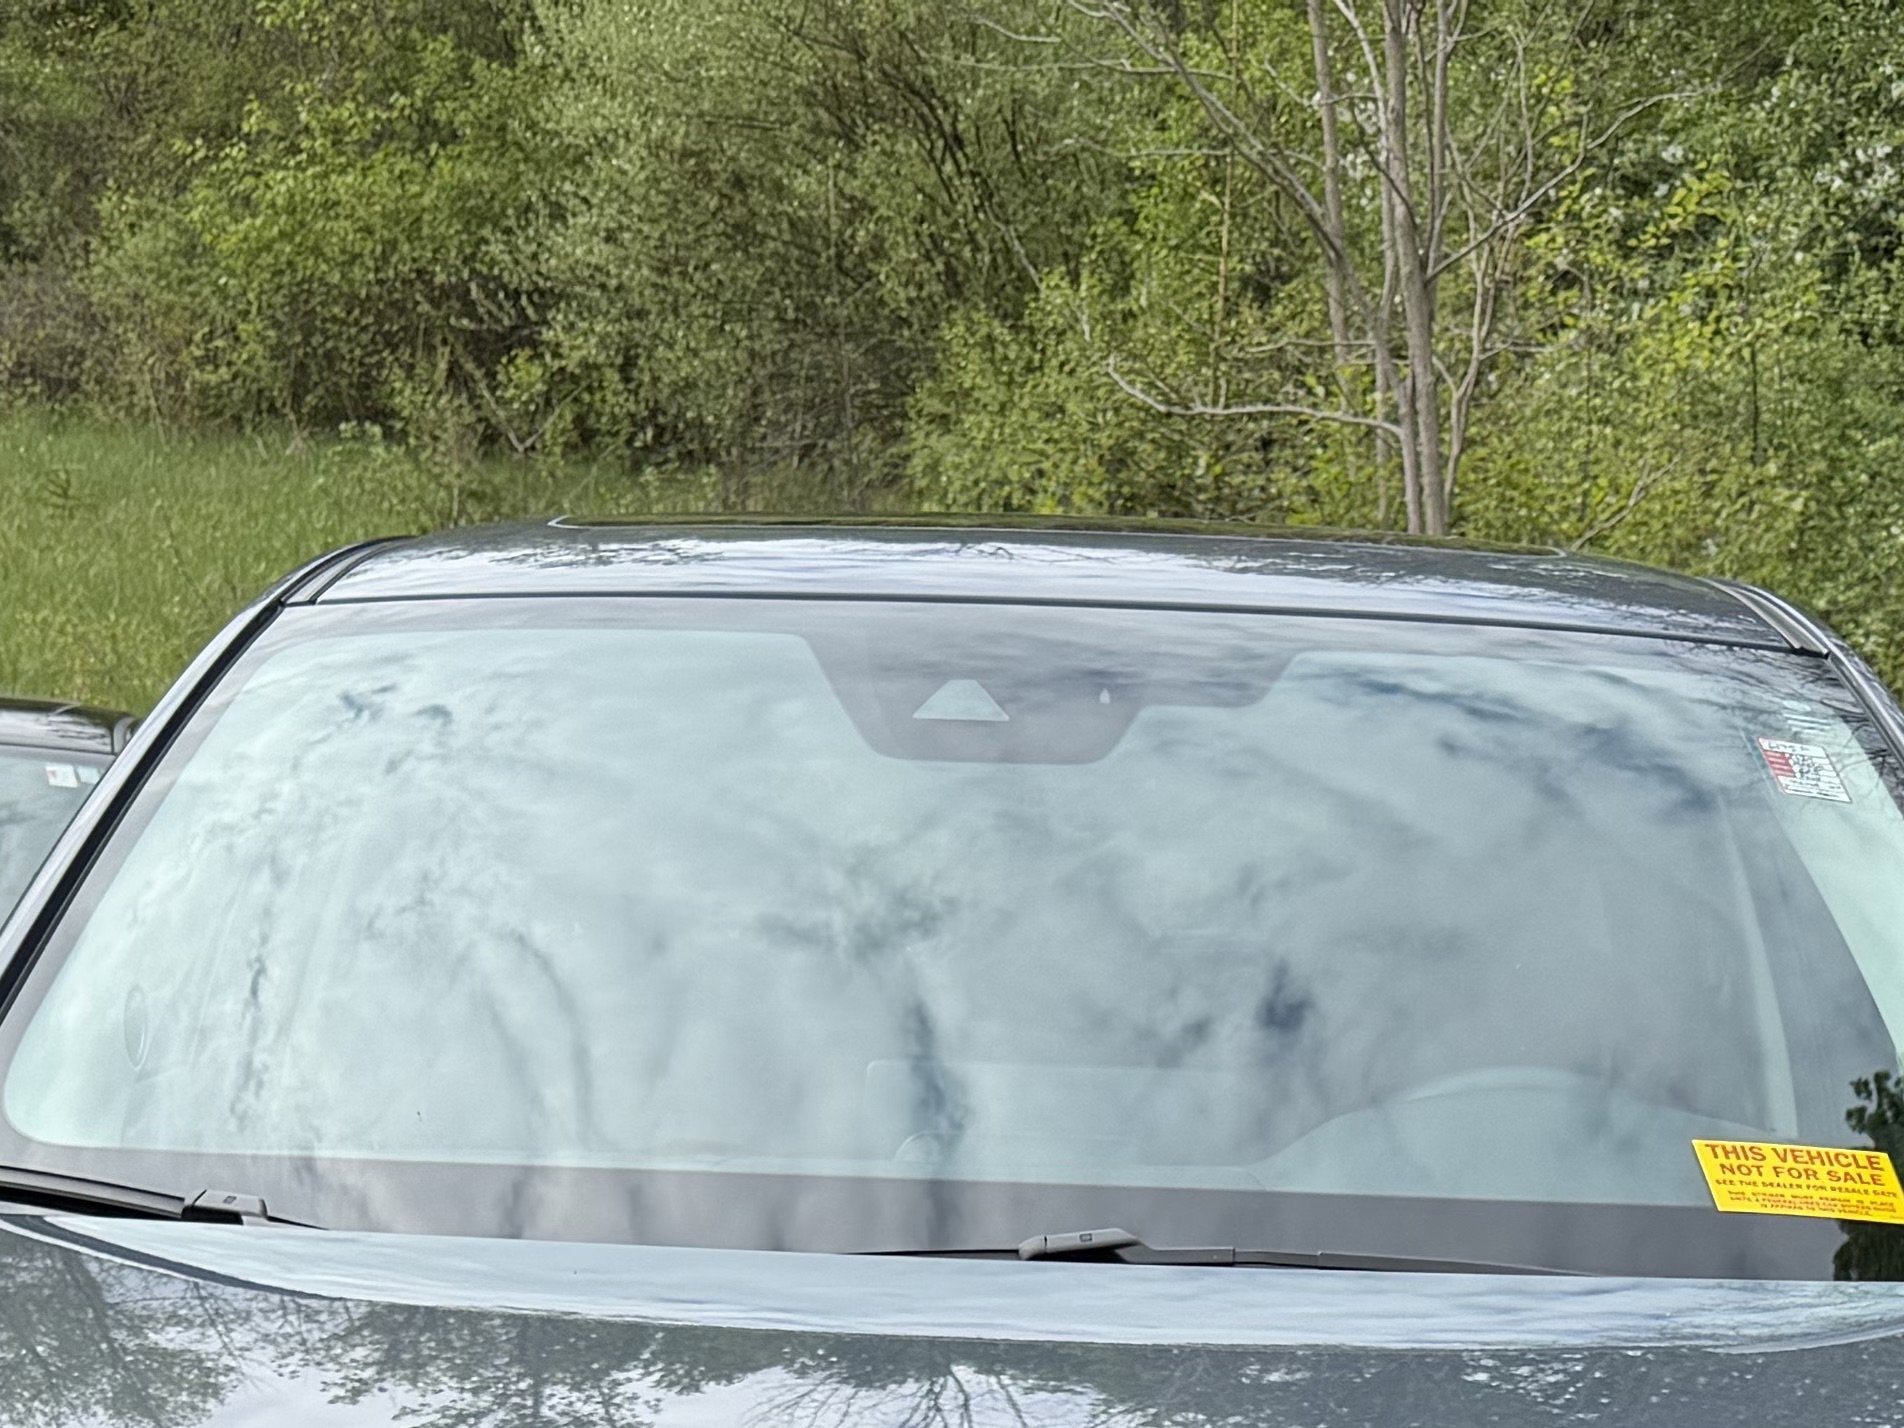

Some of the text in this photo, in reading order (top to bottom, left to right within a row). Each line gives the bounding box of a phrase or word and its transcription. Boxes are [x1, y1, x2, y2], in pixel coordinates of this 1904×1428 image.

[1704, 1143, 1885, 1171] THIS VEHICLE
[1719, 1163, 1885, 1186] NOT FOR SALE
